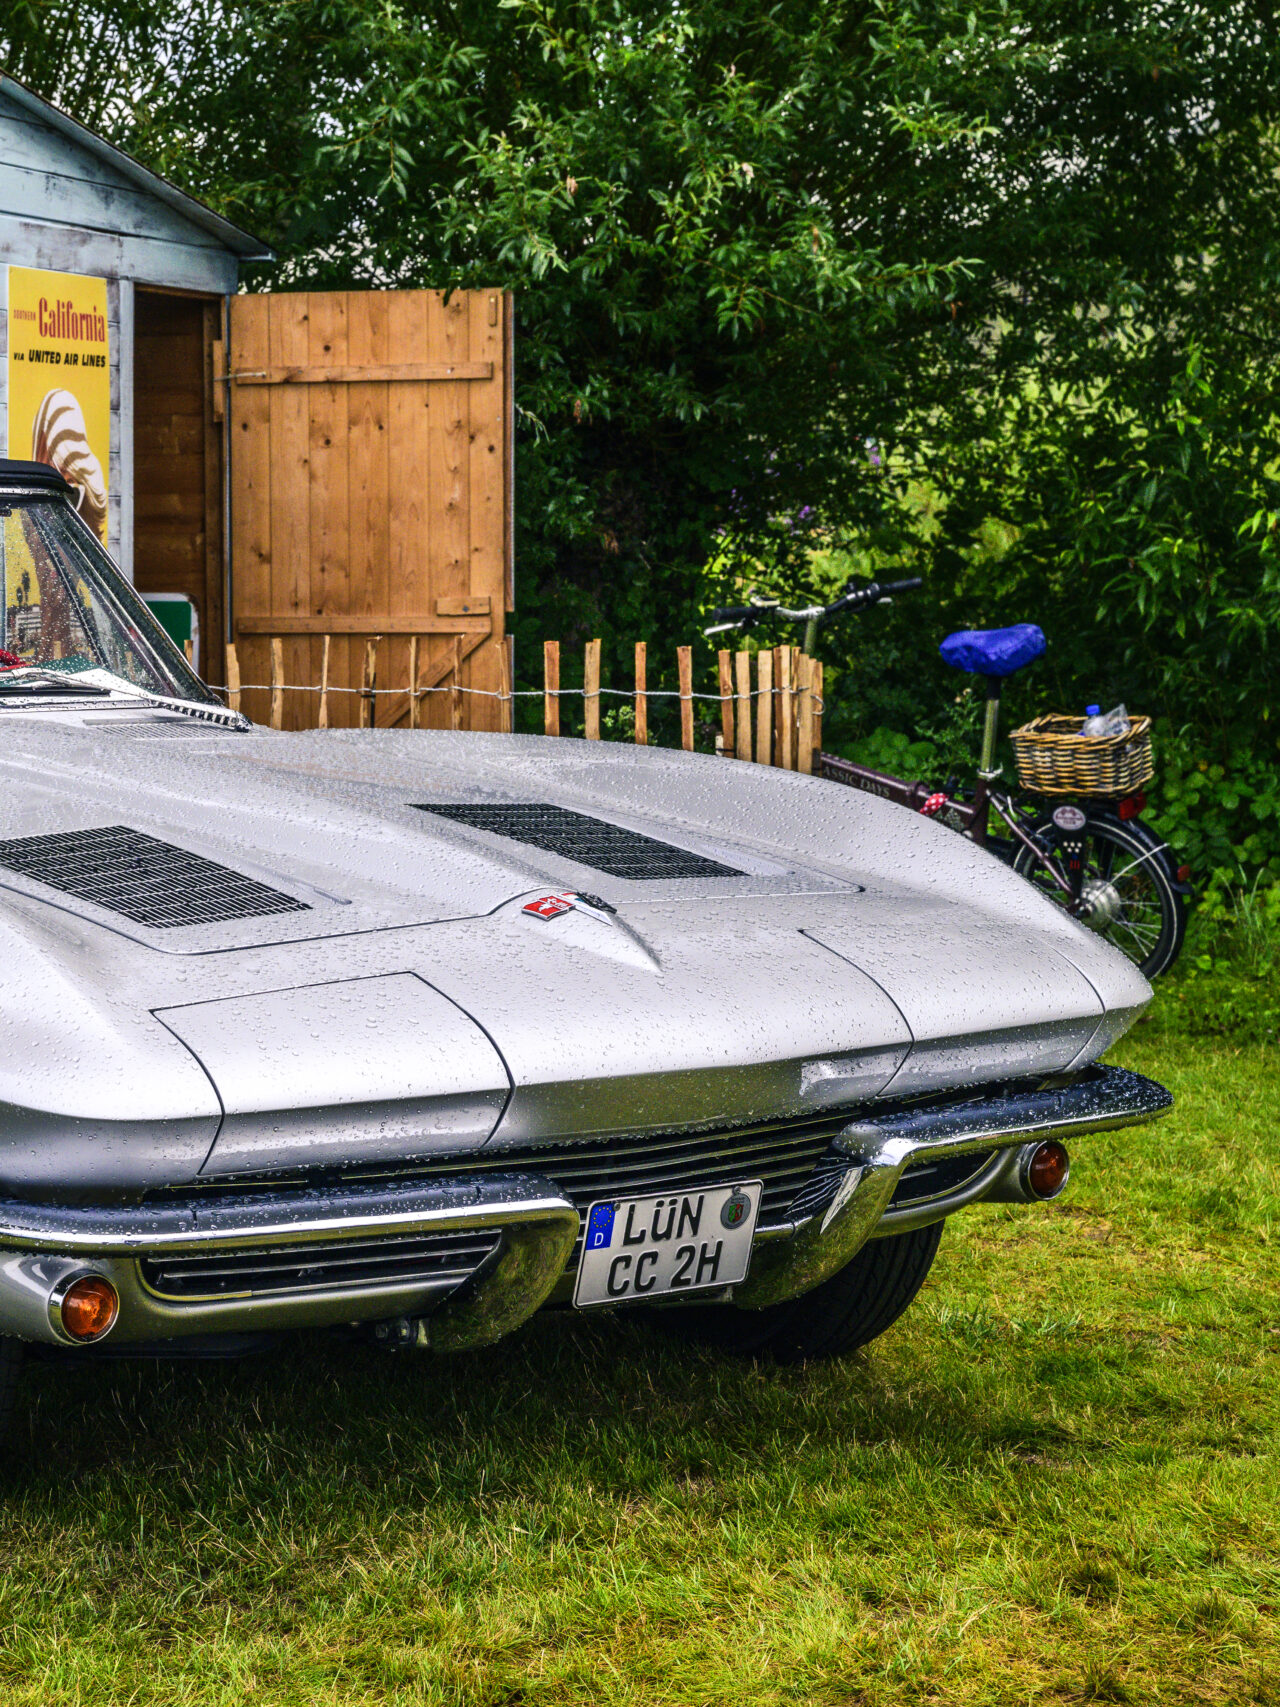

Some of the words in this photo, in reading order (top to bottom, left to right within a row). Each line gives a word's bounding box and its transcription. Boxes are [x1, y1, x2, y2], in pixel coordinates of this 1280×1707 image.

[39, 297, 105, 342] California
[13, 352, 24, 361] VIA
[28, 349, 61, 364] UNITED
[64, 353, 78, 366] AIR
[82, 354, 106, 368] LINES
[593, 1232, 604, 1247] D
[607, 1250, 659, 1296] CC
[670, 1239, 723, 1288] 2H
